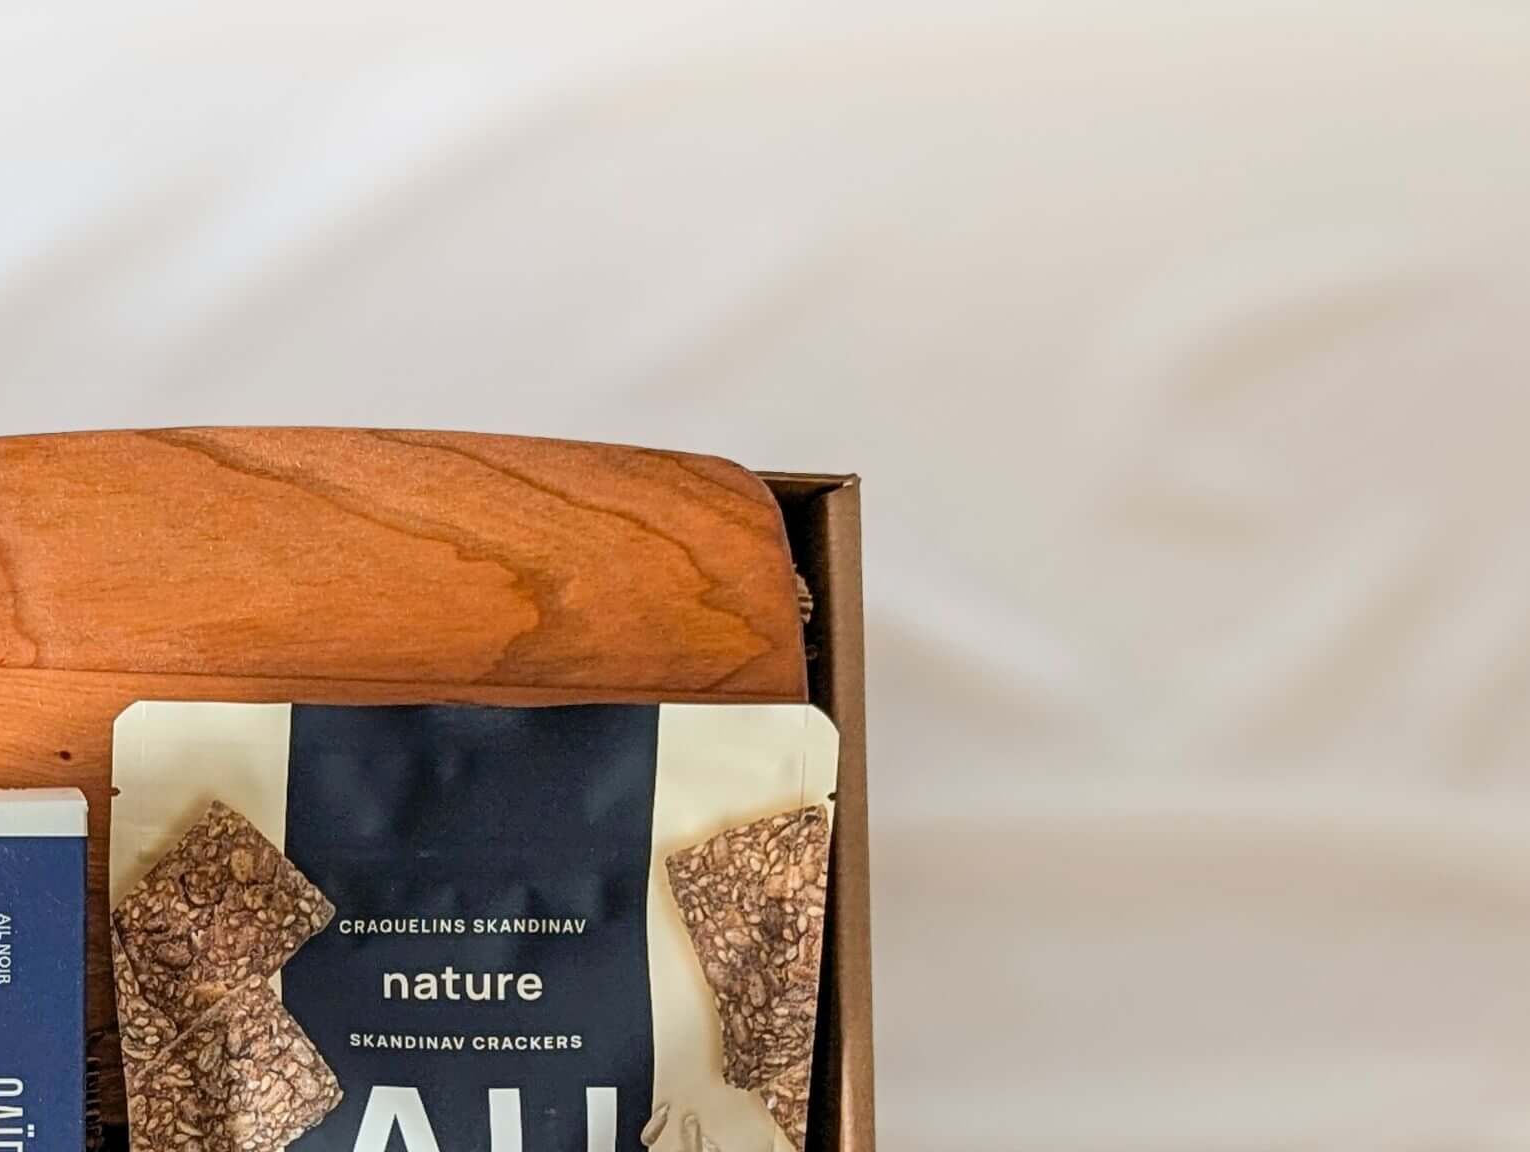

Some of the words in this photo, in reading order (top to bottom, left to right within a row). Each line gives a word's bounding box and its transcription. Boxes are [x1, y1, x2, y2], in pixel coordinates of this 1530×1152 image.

[339, 919, 465, 934] CRAQUELINS
[473, 919, 586, 934] SKANDINAV
[383, 966, 543, 1000] nature
[350, 1033, 465, 1050] SKANDINAV
[472, 1035, 583, 1050] CRACKERS
